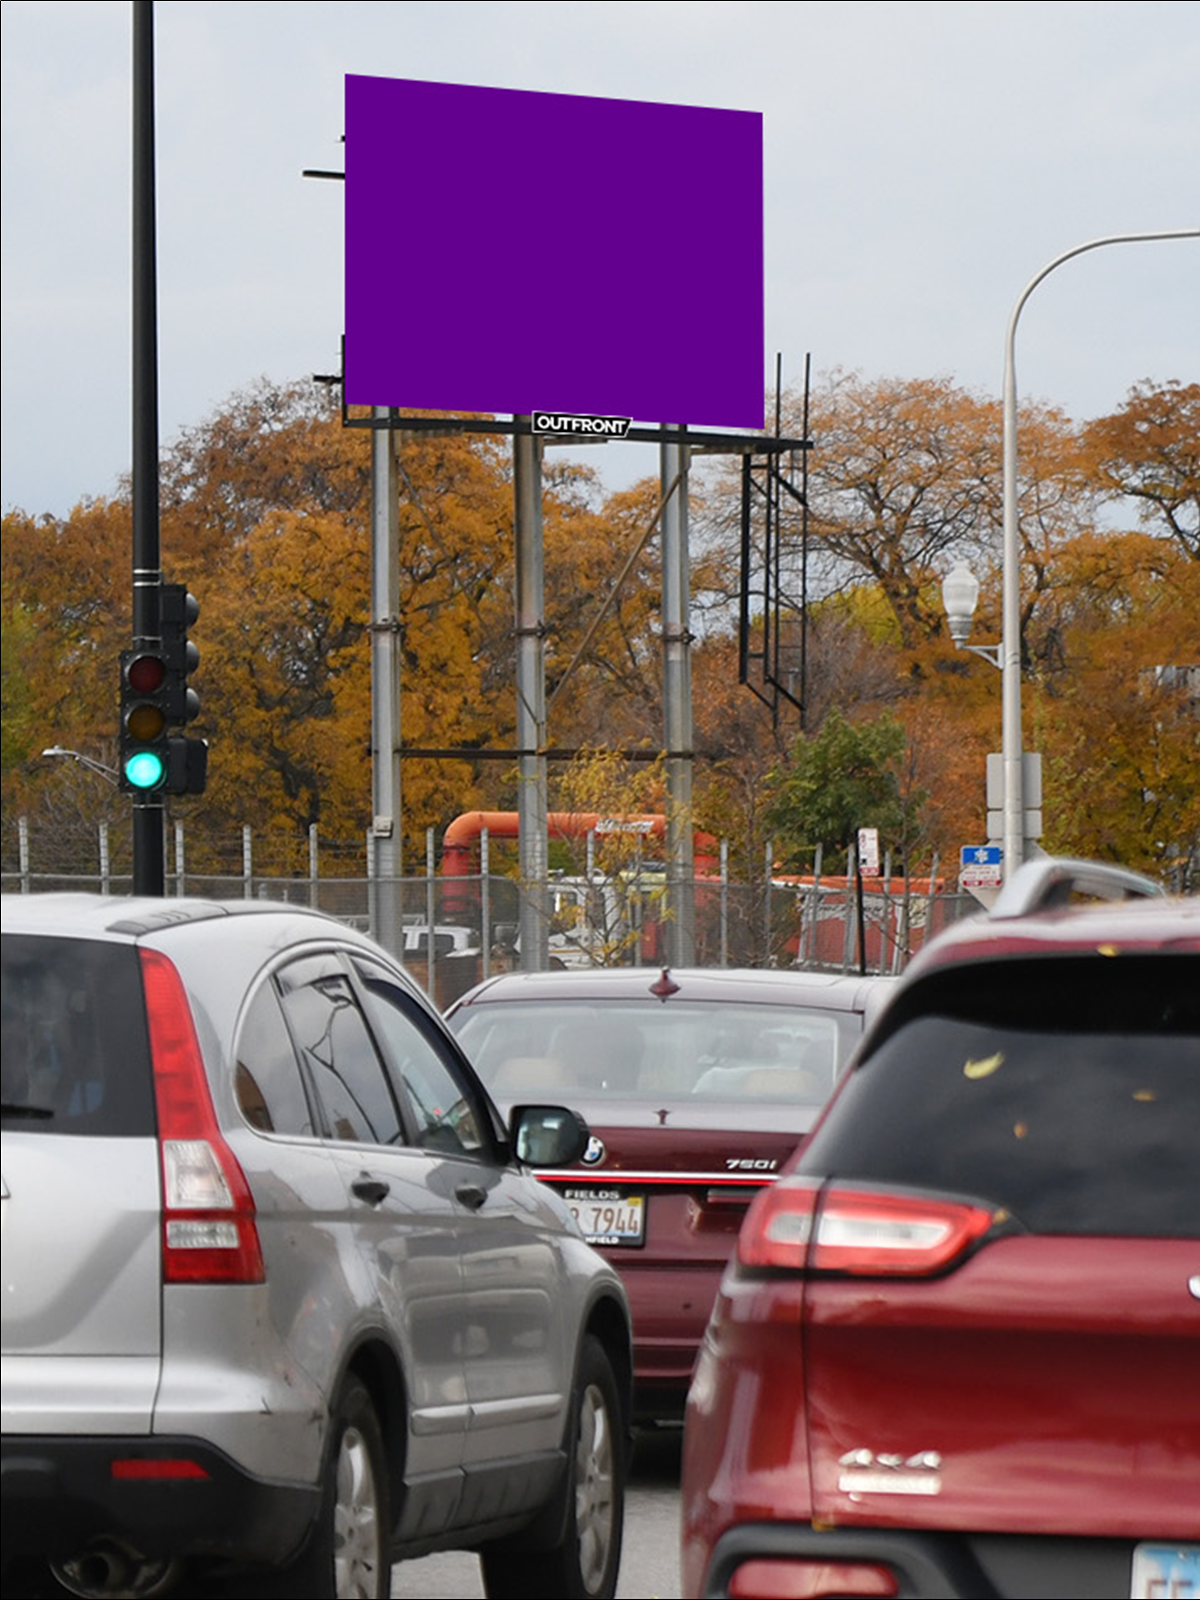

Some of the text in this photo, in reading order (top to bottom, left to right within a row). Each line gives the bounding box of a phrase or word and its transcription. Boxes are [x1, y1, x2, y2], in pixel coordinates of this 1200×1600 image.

[537, 415, 627, 434] OUTFRONT
[564, 1189, 620, 1200] FIELDS
[591, 1207, 638, 1234] 7944
